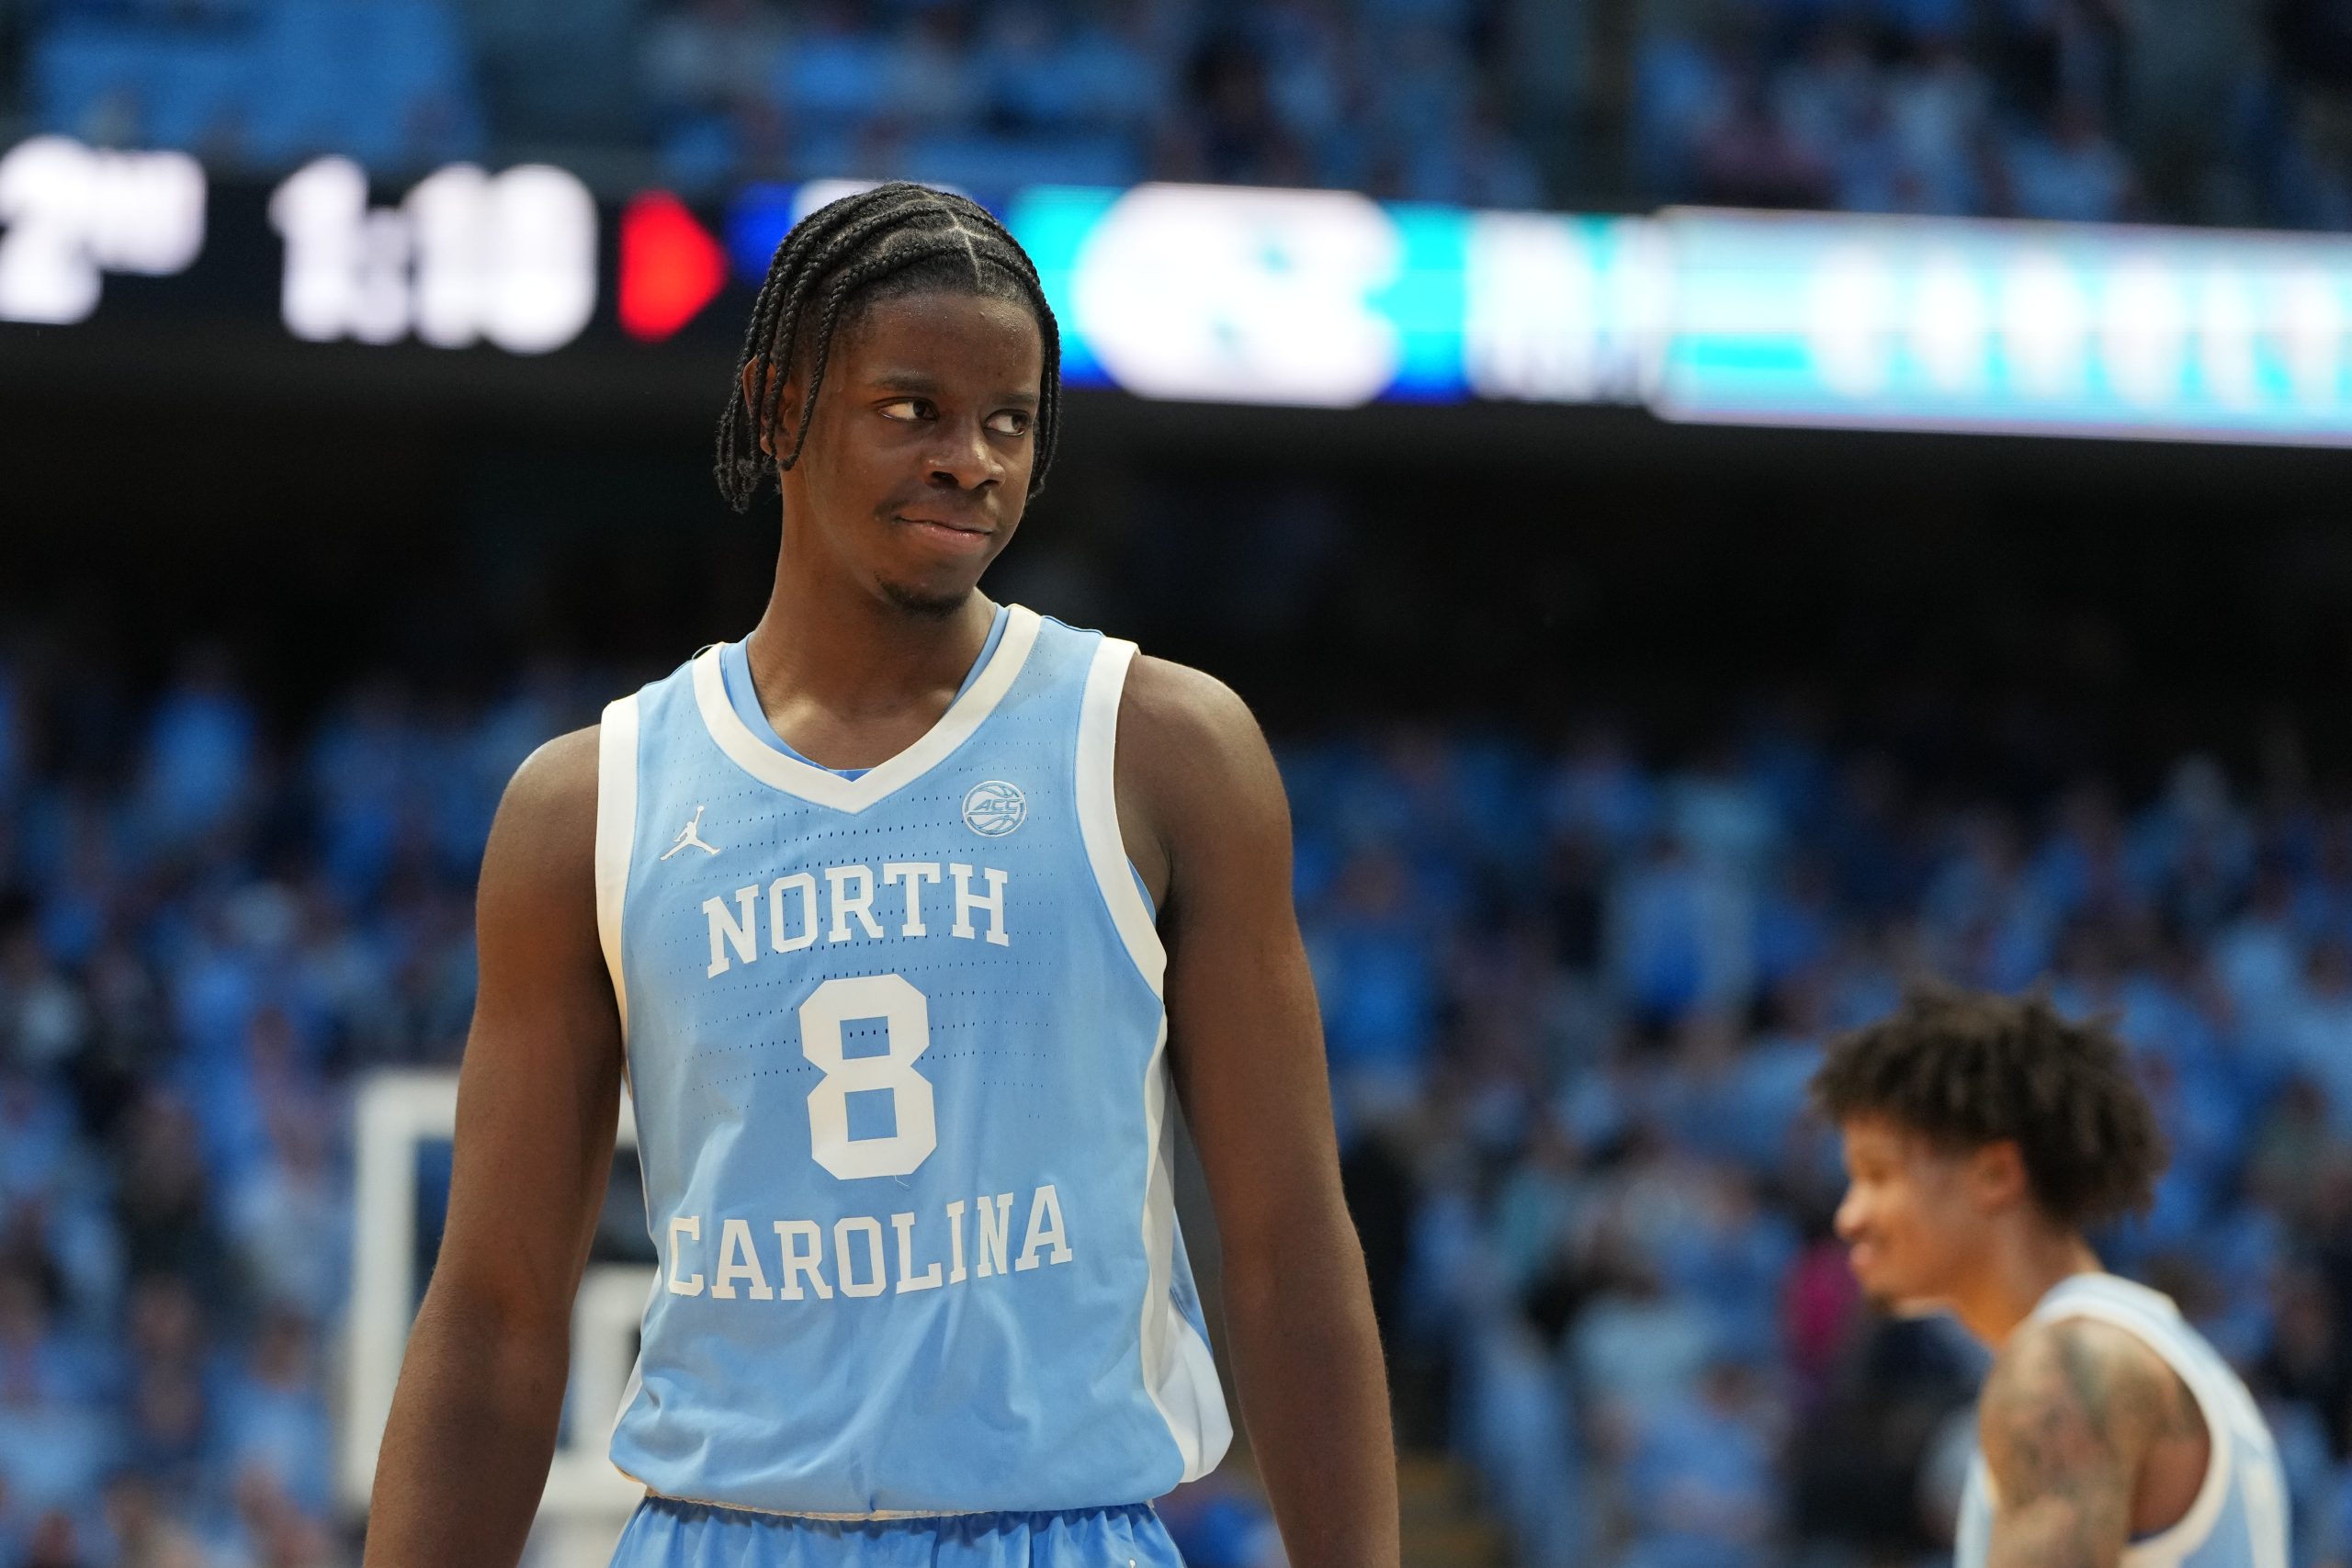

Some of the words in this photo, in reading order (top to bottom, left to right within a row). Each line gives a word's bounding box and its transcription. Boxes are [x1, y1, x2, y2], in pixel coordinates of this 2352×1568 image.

[974, 798, 1021, 812] ACC
[703, 863, 1010, 979] NORTH
[798, 974, 937, 1180] 8
[668, 1185, 1072, 1301] CAROLINA
